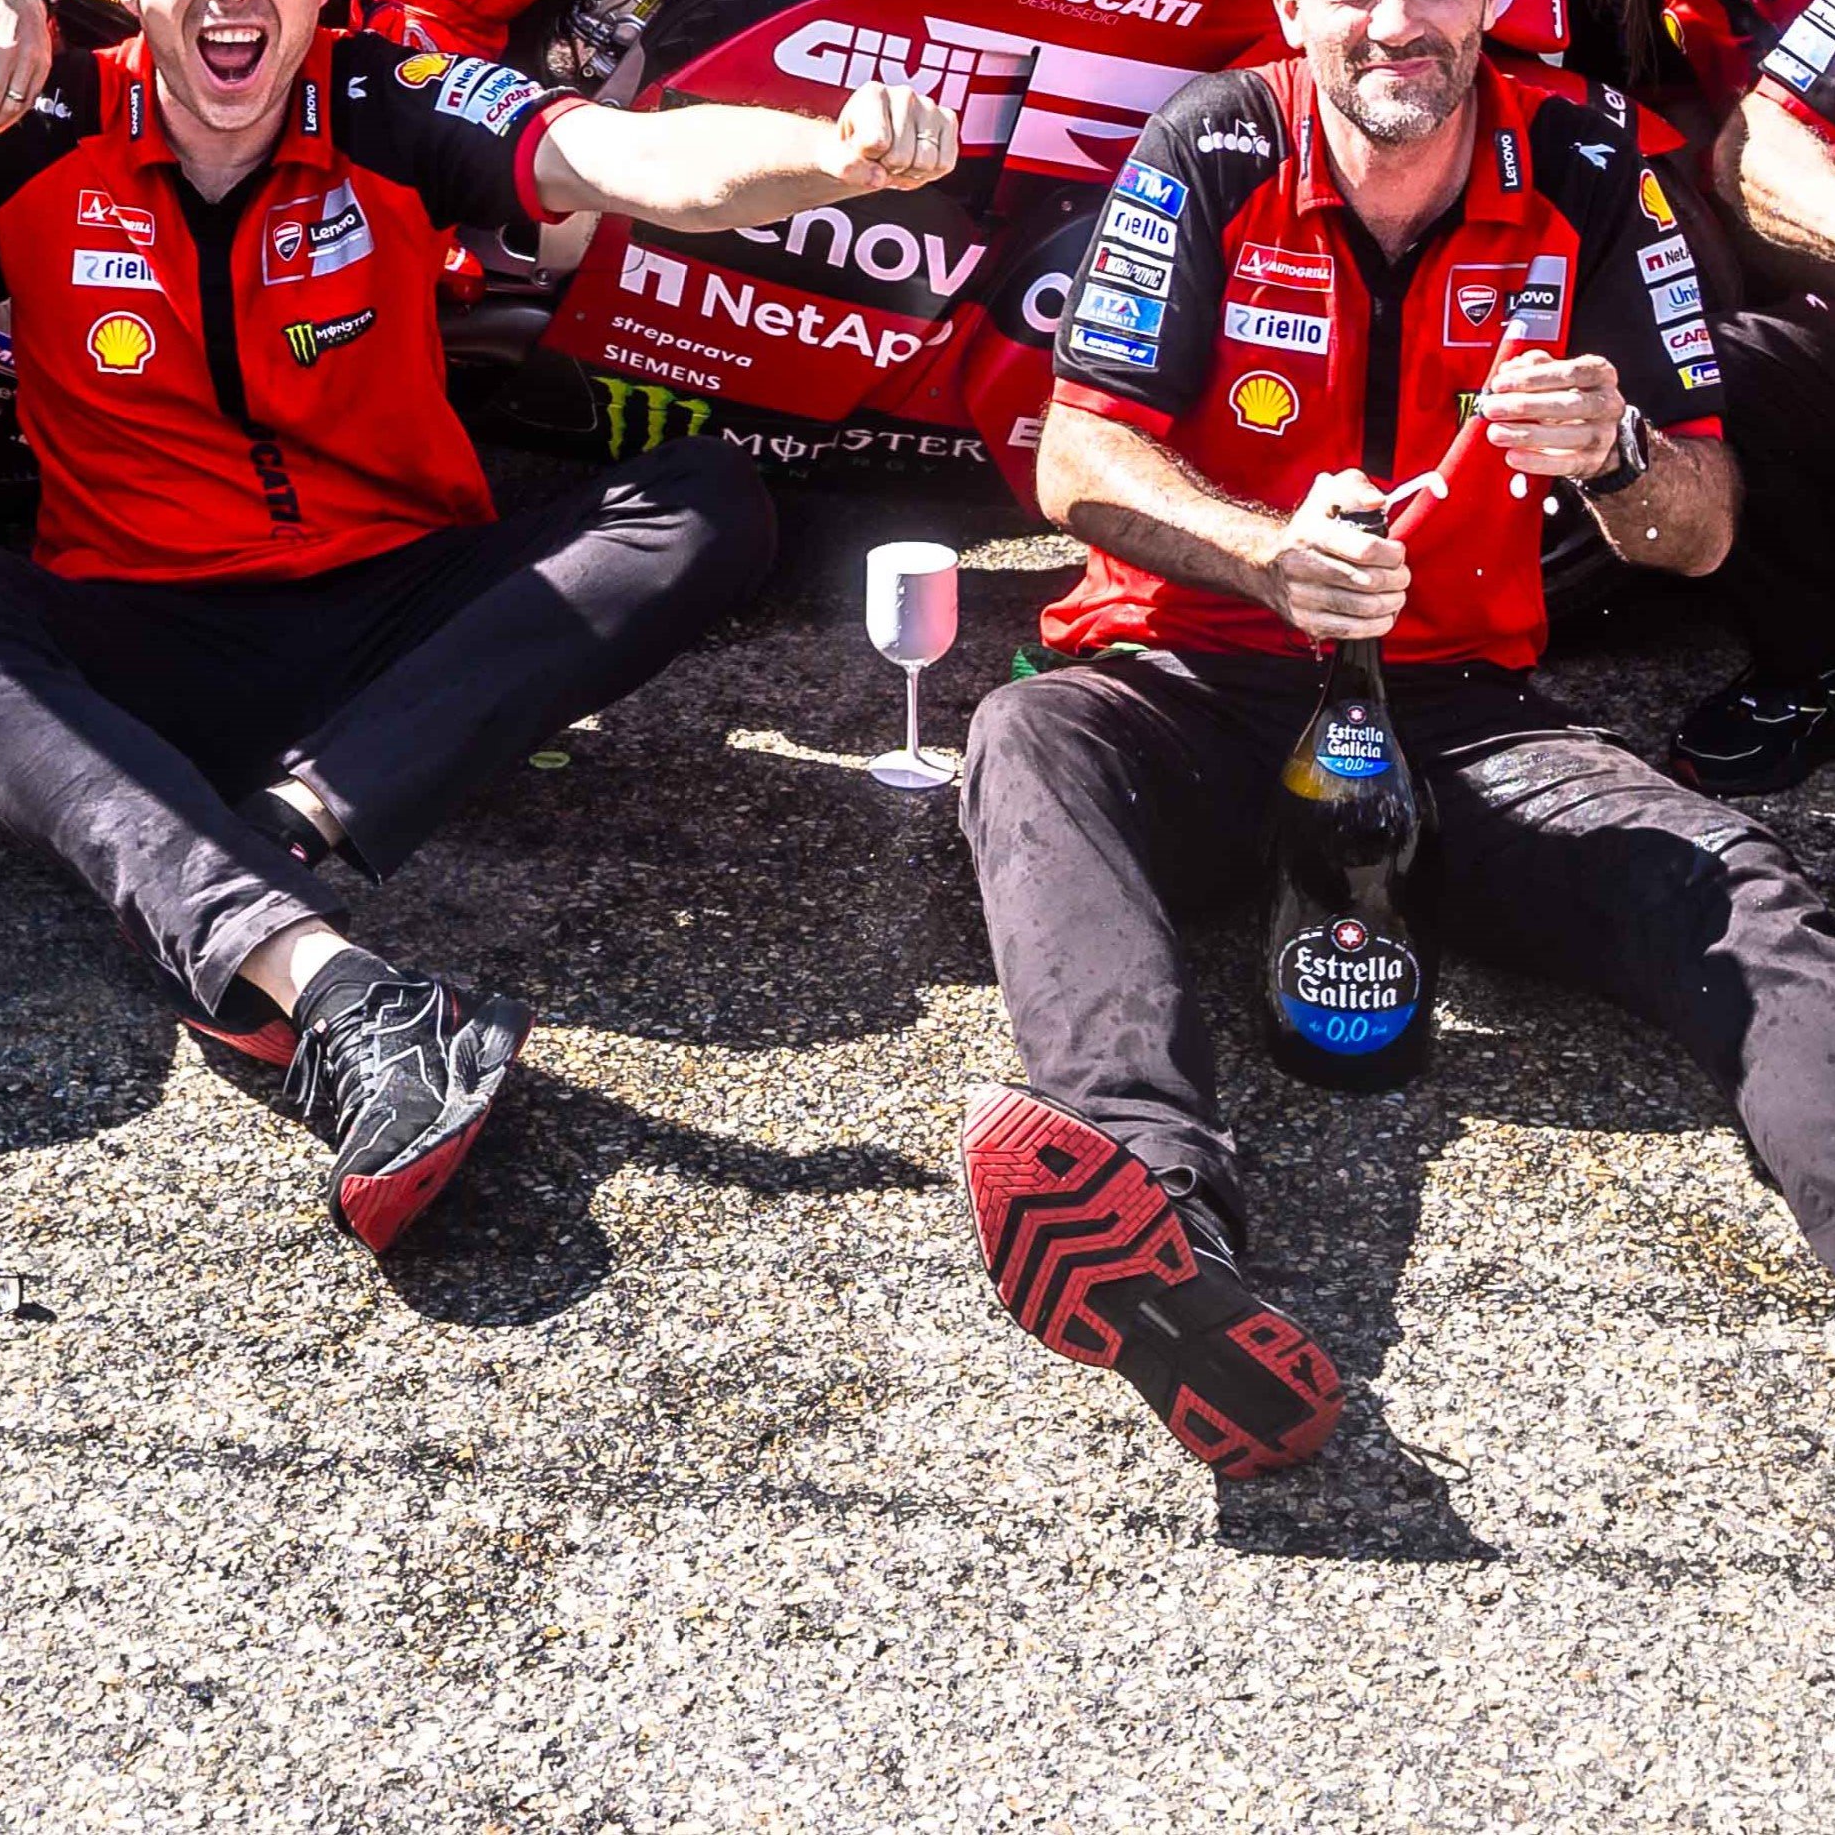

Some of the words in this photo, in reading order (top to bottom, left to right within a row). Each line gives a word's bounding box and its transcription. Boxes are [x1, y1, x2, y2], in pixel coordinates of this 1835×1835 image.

[454, 61, 486, 89] NetA
[129, 83, 139, 134] Lenovo
[305, 83, 316, 133] Lenovo
[1196, 117, 1271, 157] diadora
[1504, 134, 1519, 186] Lenovo
[1135, 169, 1173, 204] TIM
[311, 214, 356, 241] Lenovo
[1115, 211, 1169, 244] riello
[1268, 260, 1331, 282] AUTOGRILL
[1510, 290, 1554, 310] Lovo
[316, 310, 373, 340] MONSTER
[611, 313, 753, 366] streparava
[1251, 312, 1322, 345] riello
[604, 343, 721, 390] SIEMENS
[1327, 722, 1383, 743] Estrella
[1328, 739, 1382, 759] Galicia
[1295, 947, 1403, 982] Estrella
[1297, 973, 1397, 1009] Galicia
[1326, 1016, 1369, 1042] 0,0
